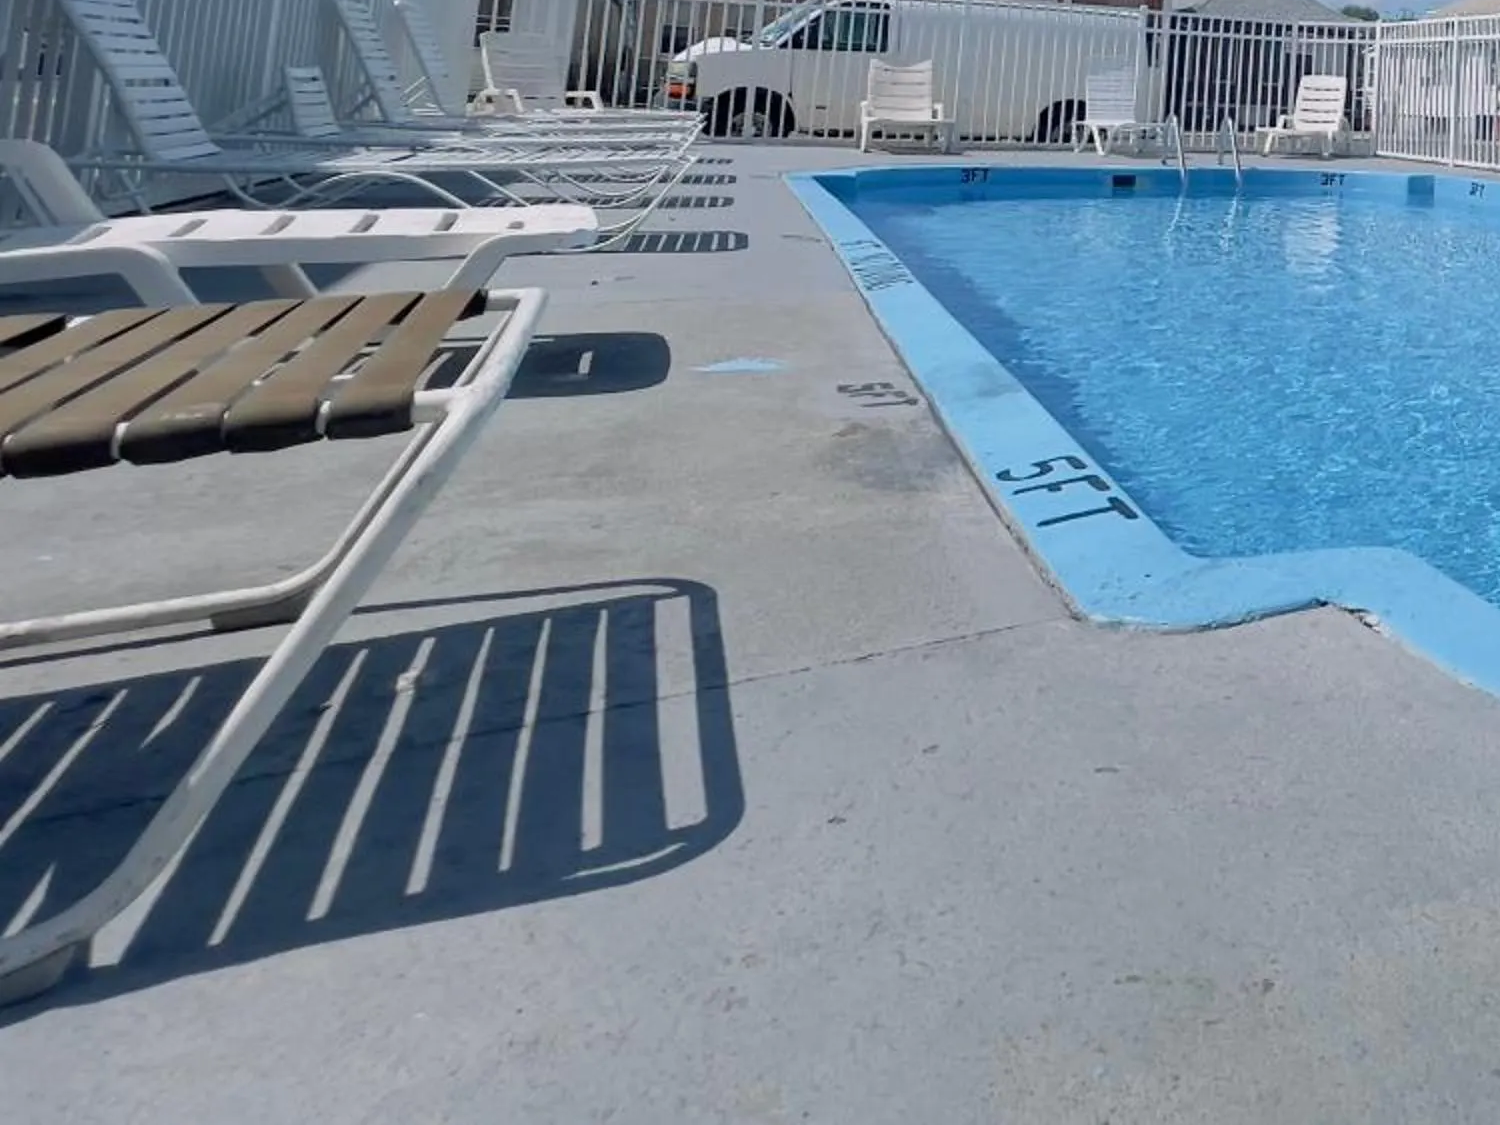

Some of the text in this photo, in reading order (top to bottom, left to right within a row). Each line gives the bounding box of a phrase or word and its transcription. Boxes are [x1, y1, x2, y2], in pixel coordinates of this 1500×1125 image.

[960, 167, 989, 184] 3FT
[837, 382, 918, 408] 5FT
[996, 455, 1139, 527] 5FT
